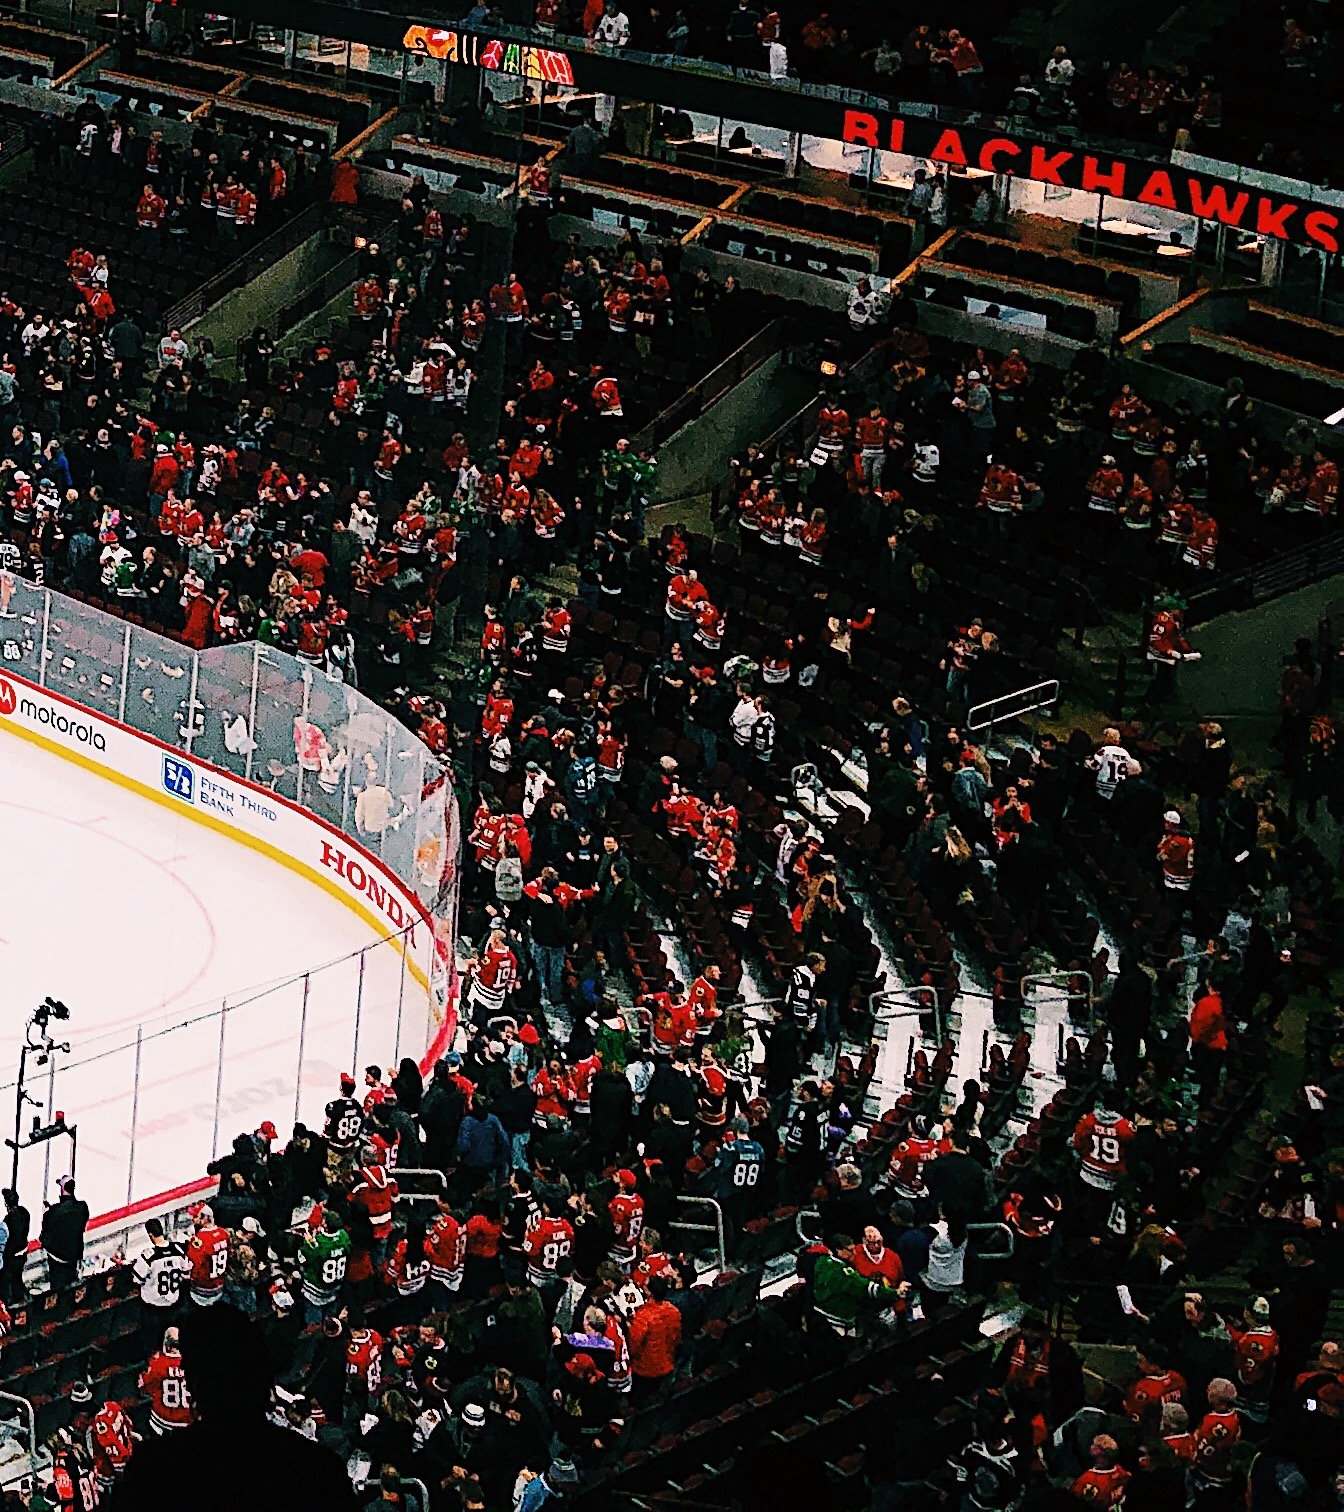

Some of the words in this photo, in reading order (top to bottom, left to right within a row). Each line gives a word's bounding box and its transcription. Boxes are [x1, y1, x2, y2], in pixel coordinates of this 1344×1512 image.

[842, 108, 1340, 253] BLACKHAWKS
[0, 553, 13, 567] 19
[20, 697, 105, 751] motorola
[200, 792, 234, 816] BANK
[201, 777, 234, 801] FIFTH
[240, 794, 277, 822] THIRD
[338, 1117, 360, 1138] 88
[1090, 1135, 1120, 1164] 19
[733, 1165, 758, 1186] 88
[210, 1252, 228, 1278] 19
